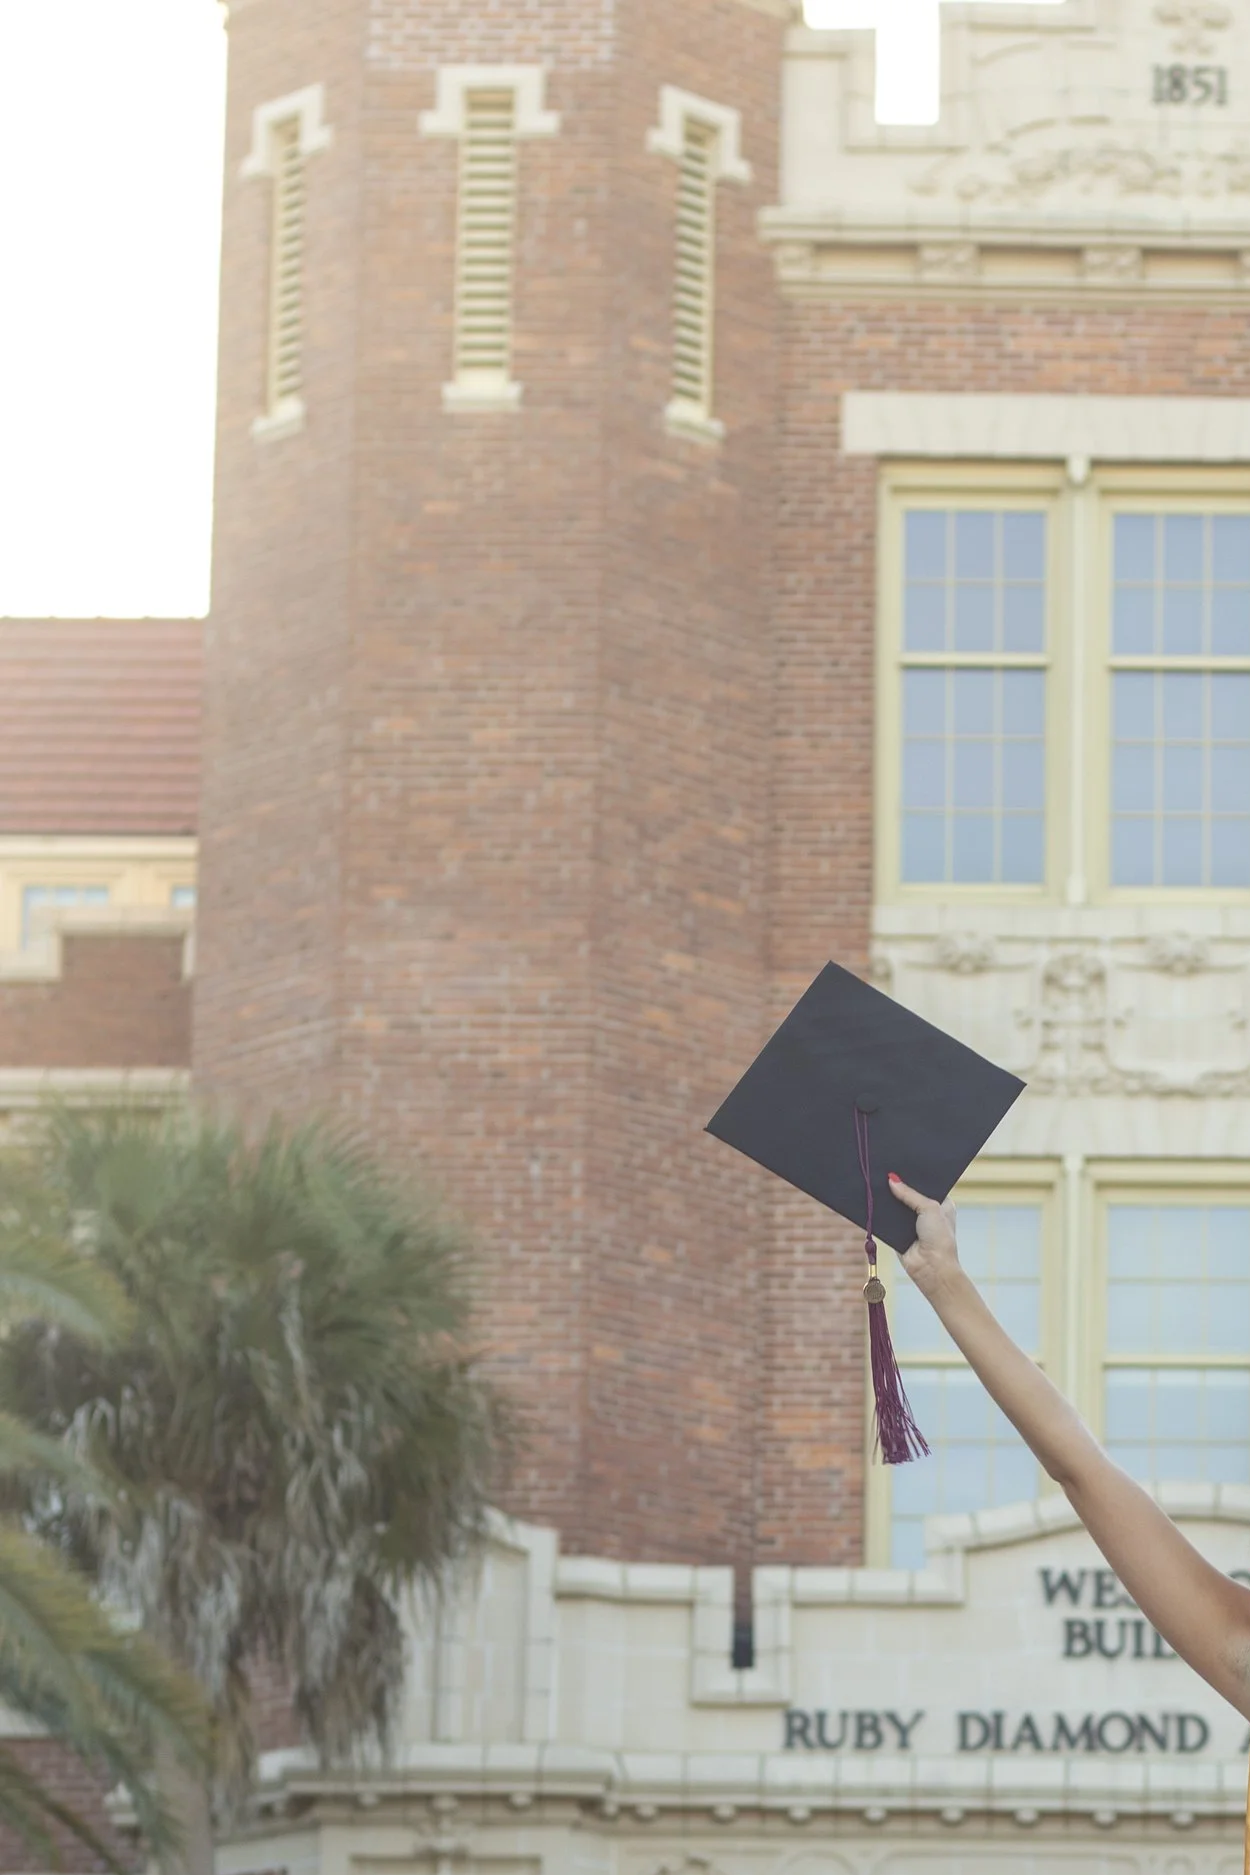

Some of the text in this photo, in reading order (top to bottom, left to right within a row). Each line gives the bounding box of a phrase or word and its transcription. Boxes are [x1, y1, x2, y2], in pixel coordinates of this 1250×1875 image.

[1152, 62, 1228, 107] 1851
[782, 1709, 924, 1753] RUBY
[956, 1710, 1210, 1755] DIAMOND
